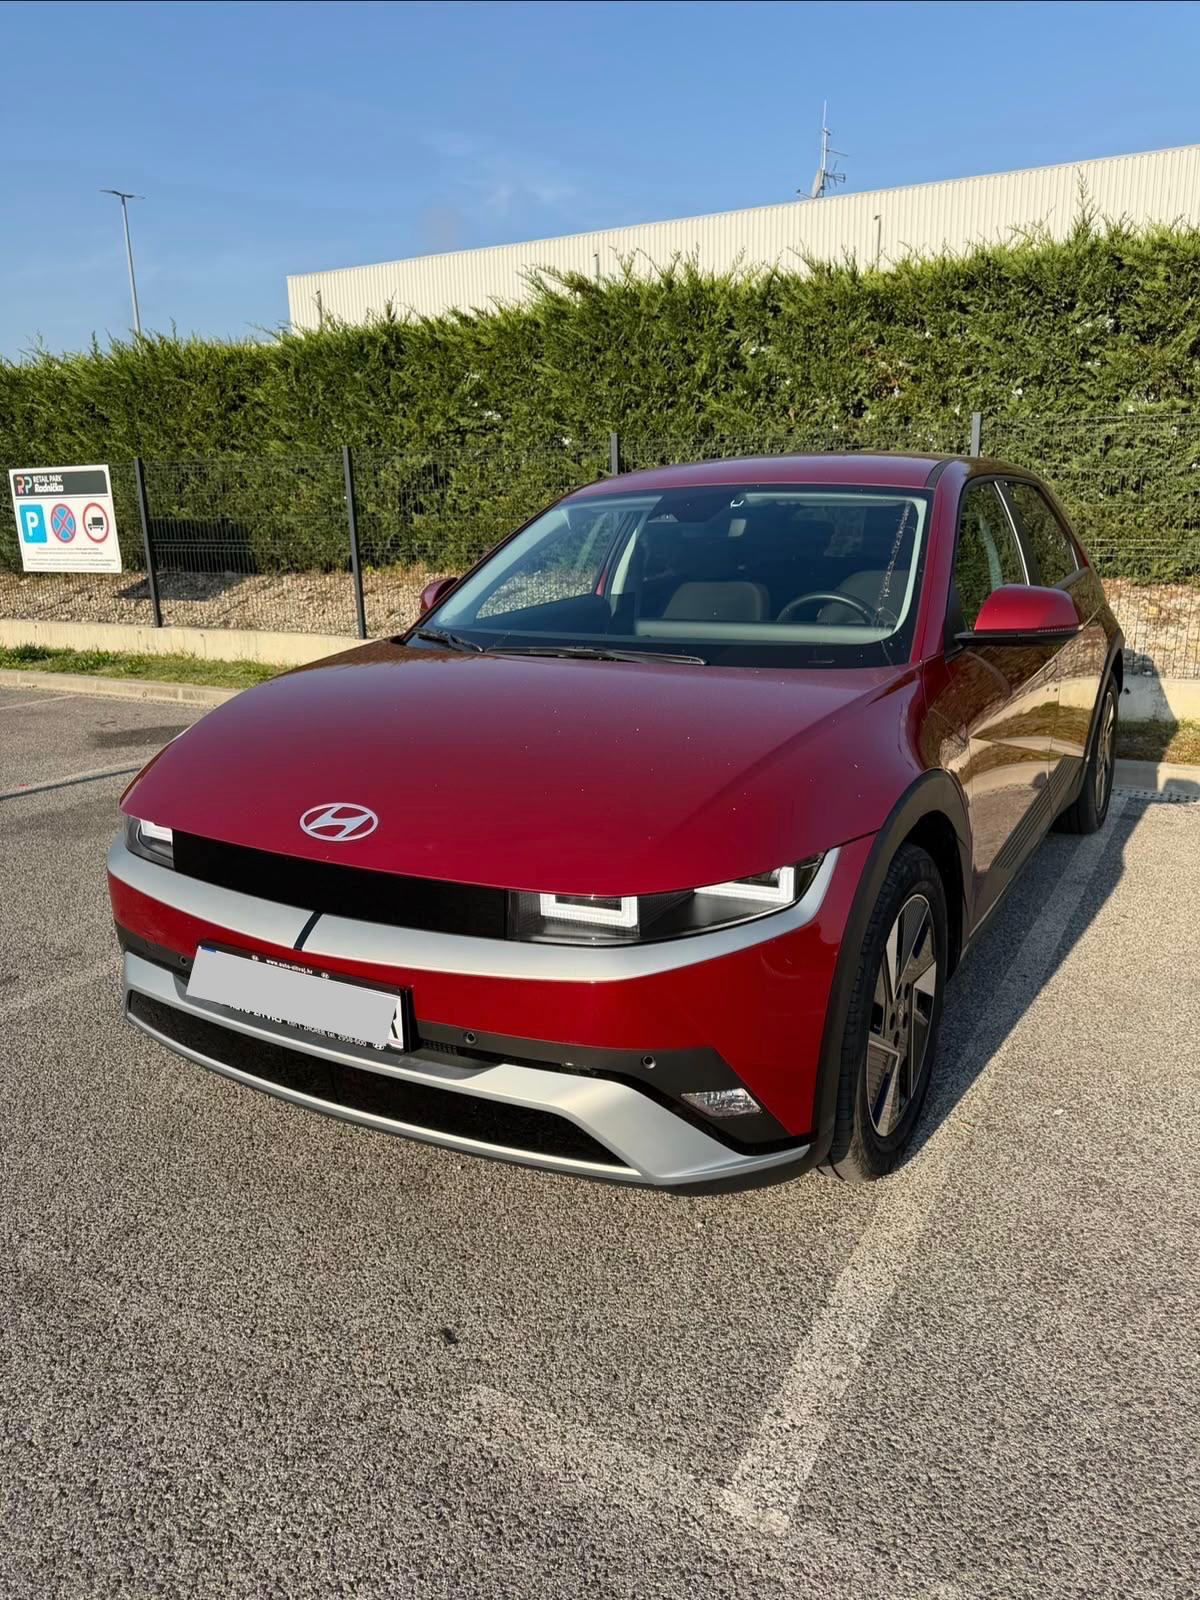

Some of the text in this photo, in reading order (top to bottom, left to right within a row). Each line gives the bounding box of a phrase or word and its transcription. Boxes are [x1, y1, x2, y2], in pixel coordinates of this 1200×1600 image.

[33, 474, 63, 483] RETAIL PARK
[25, 511, 39, 536] P
